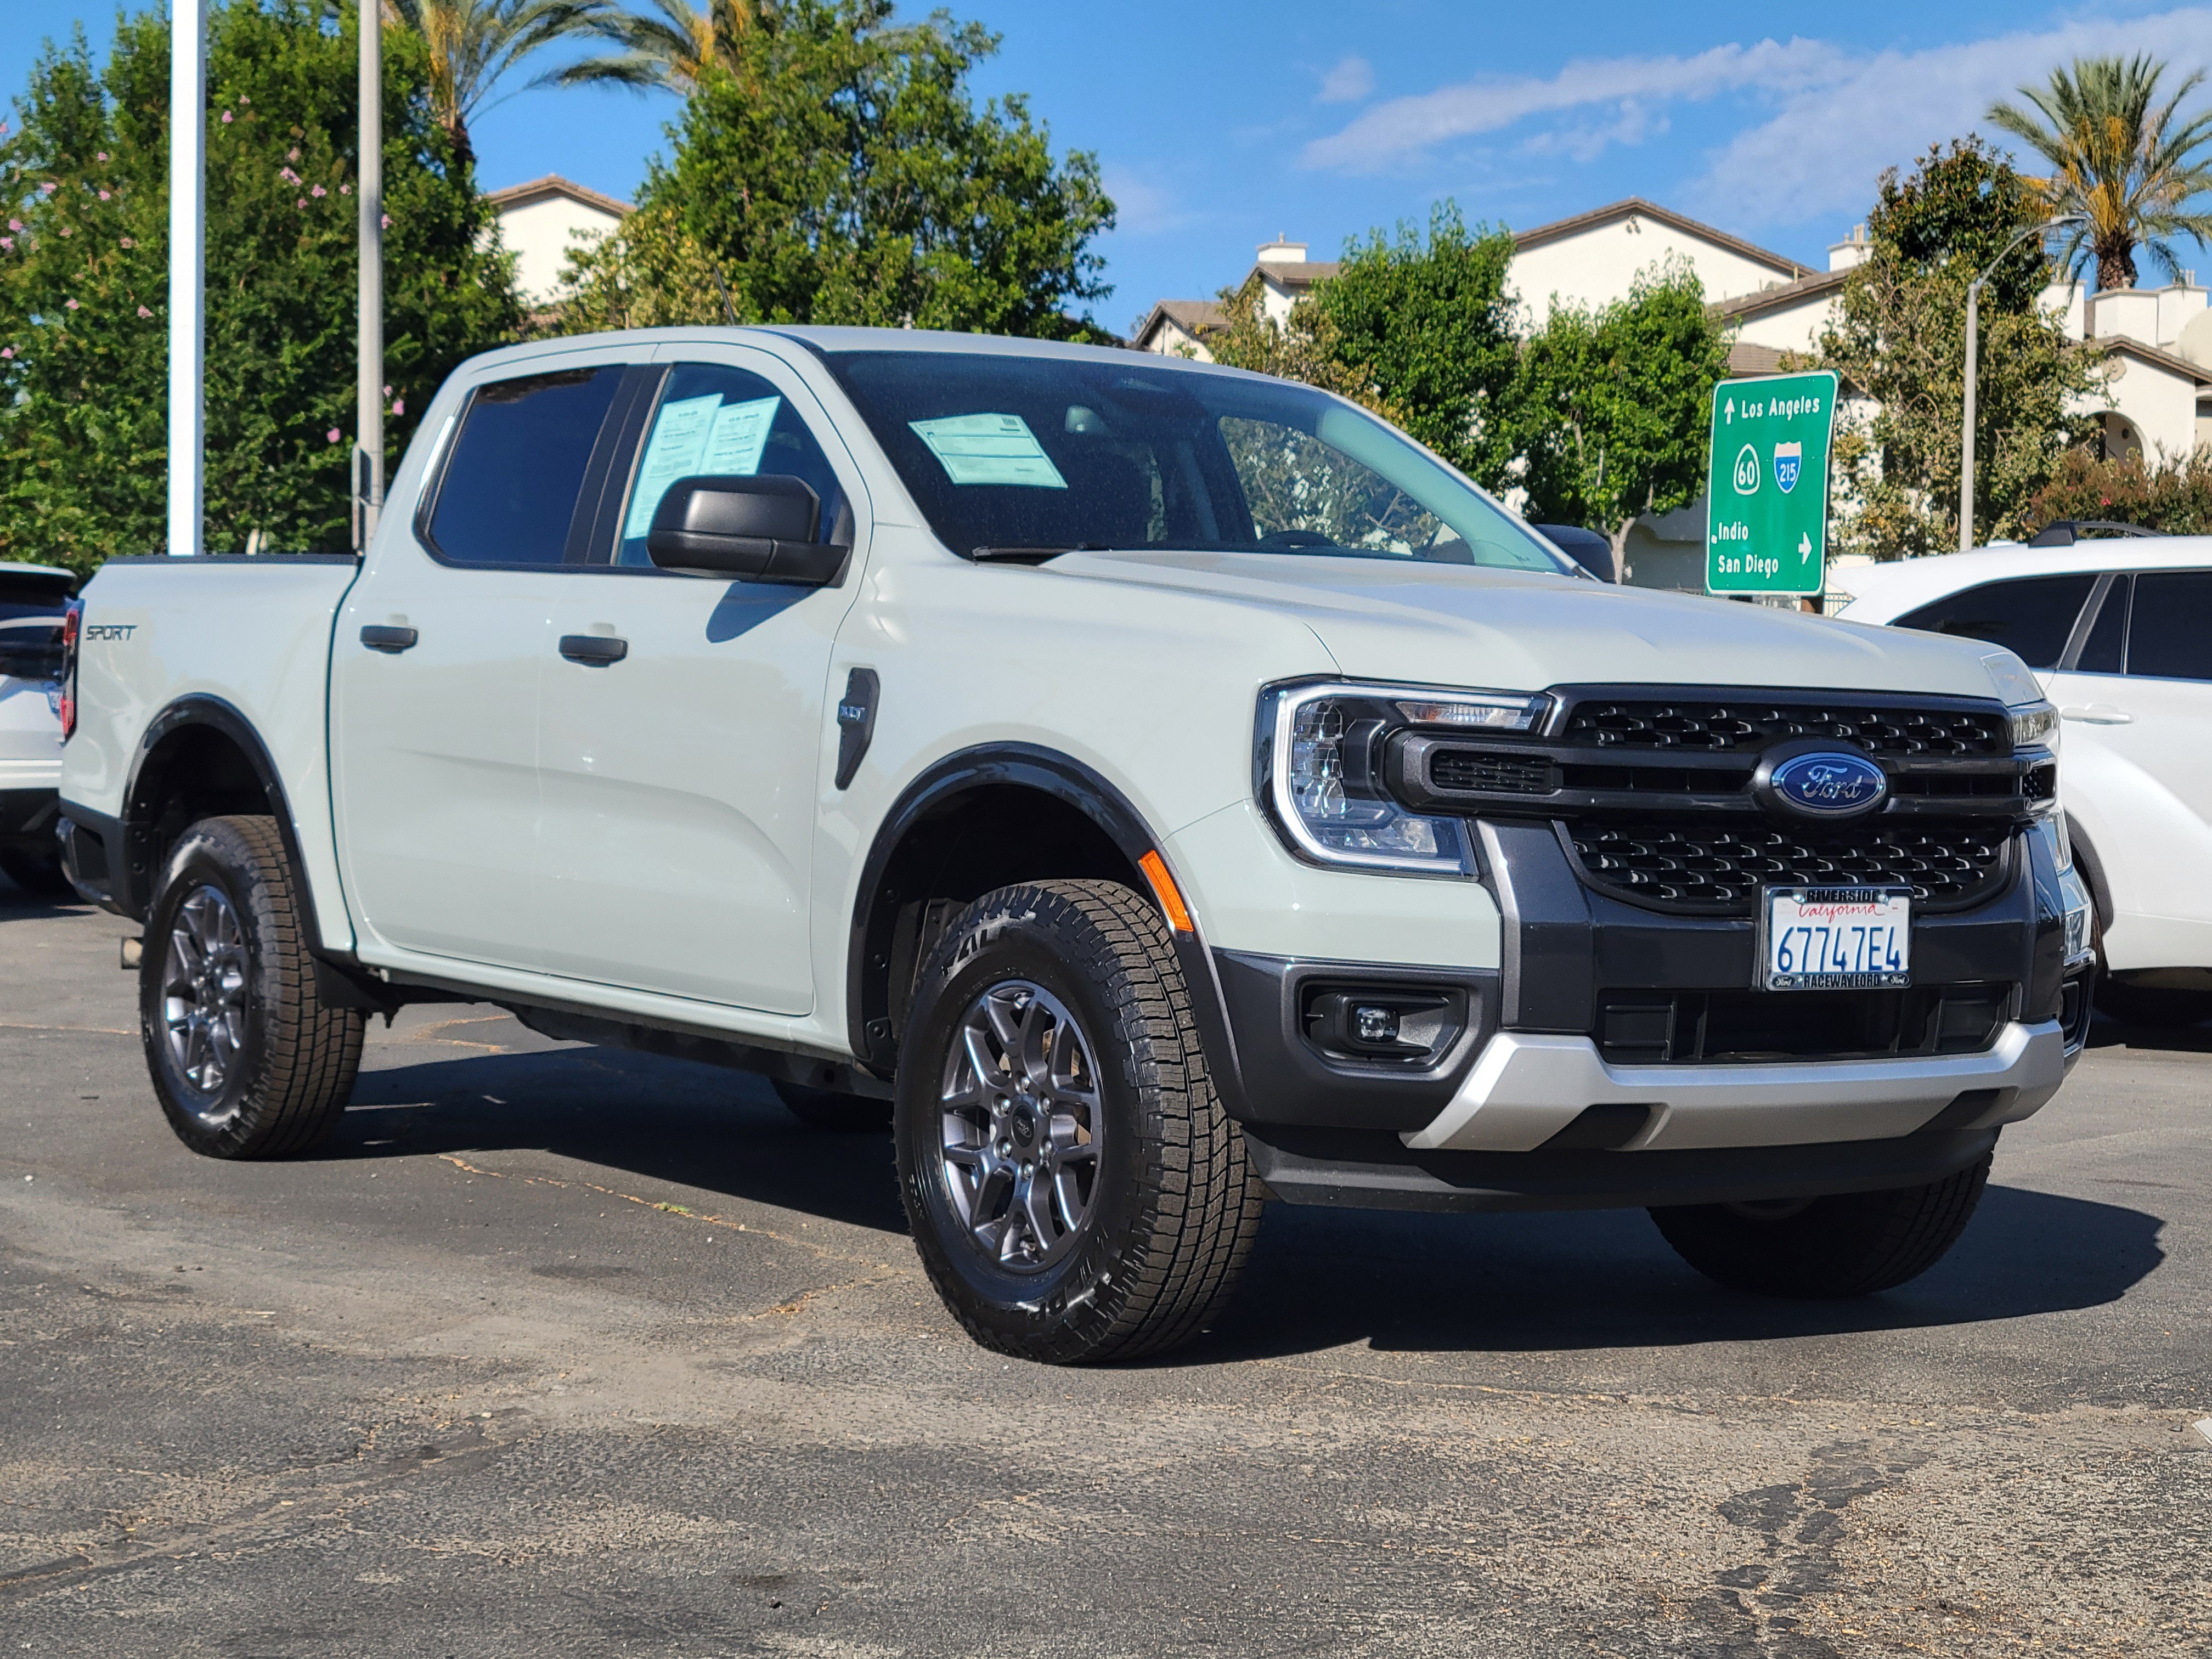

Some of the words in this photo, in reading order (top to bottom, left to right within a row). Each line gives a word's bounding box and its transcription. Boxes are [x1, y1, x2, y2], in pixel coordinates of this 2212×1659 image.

[1741, 399, 1763, 419] Los
[1769, 395, 1820, 421] Angeles
[1737, 460, 1756, 486] 60
[1780, 462, 1797, 483] 215
[1718, 521, 1748, 541] Indio
[1718, 555, 1740, 574] San
[1745, 554, 1779, 579] Diego
[86, 624, 138, 641] SPORT
[1802, 764, 1863, 799] Ford
[1807, 889, 1880, 902] RIVERSIDE
[1799, 904, 1885, 924] California
[1778, 926, 1901, 973] 67747E4
[1804, 974, 1852, 988] RACEWAY
[1854, 974, 1879, 988] FORD
